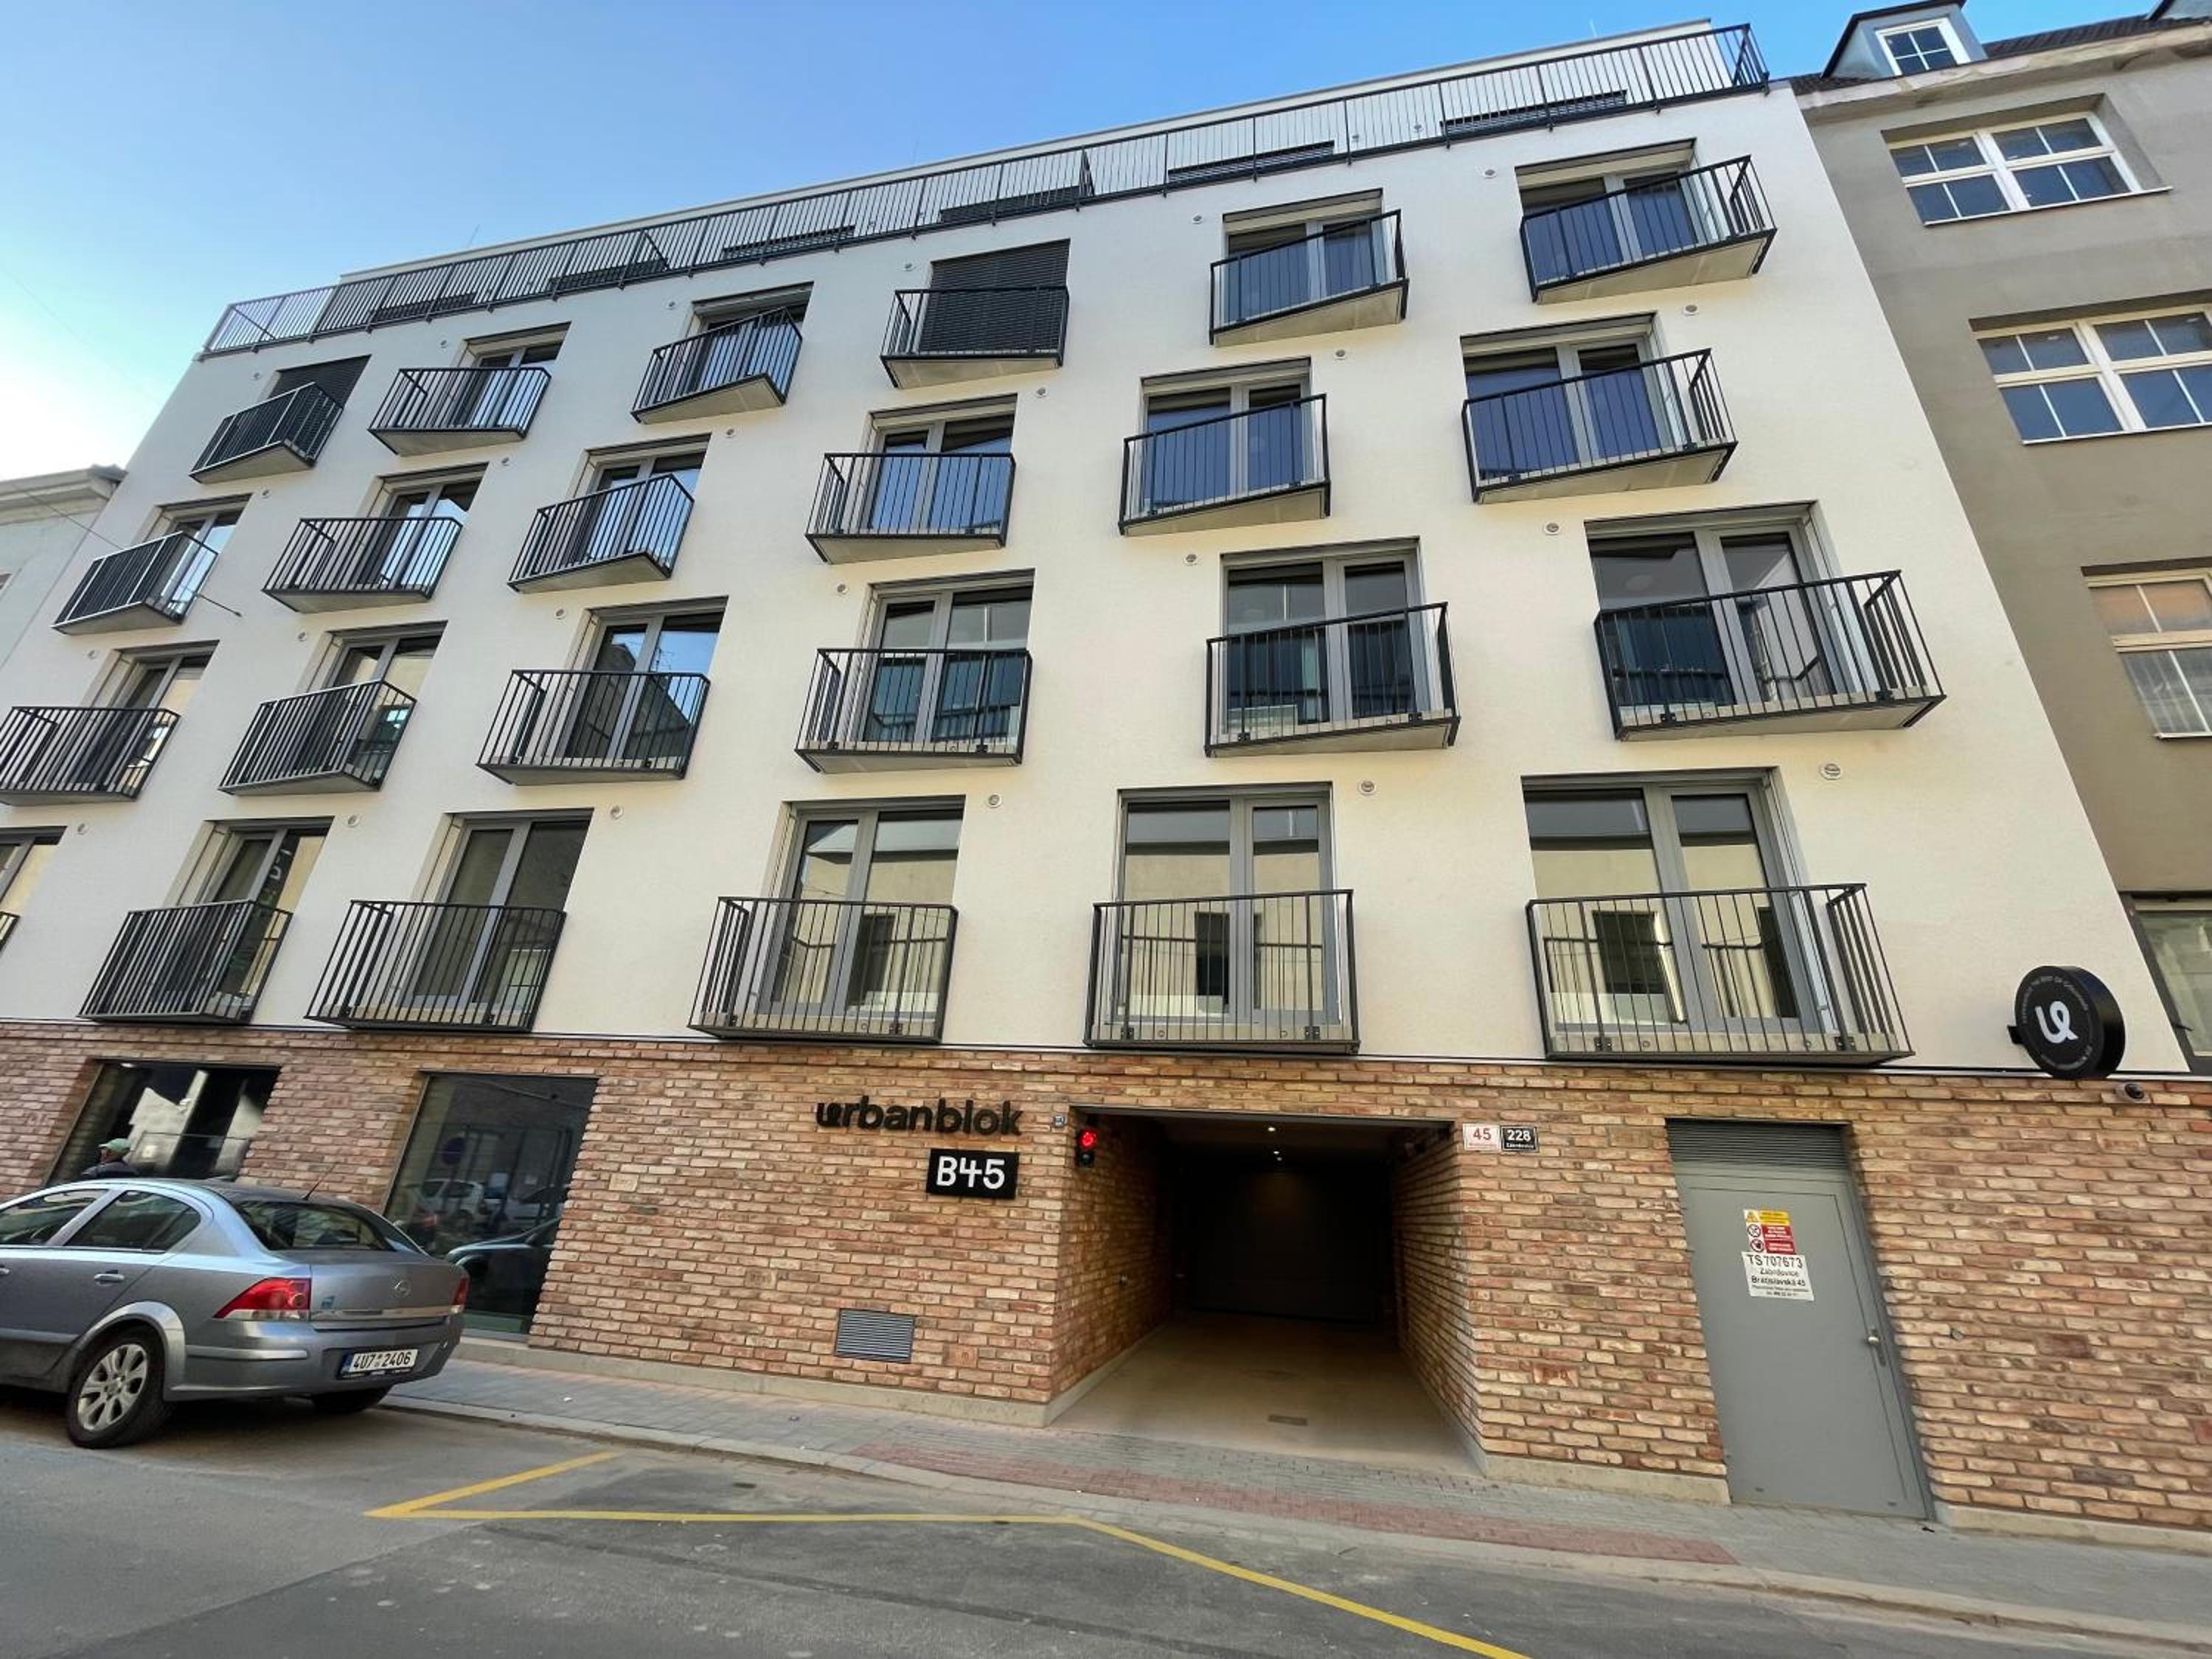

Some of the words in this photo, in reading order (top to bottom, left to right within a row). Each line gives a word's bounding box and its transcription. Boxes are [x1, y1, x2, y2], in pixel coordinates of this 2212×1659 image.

[815, 1096, 1023, 1136] urbanblok
[1472, 1127, 1492, 1141] 45
[1506, 1129, 1531, 1141] 228
[936, 1155, 1006, 1189] B45
[1747, 1254, 1763, 1266] TS
[353, 1354, 375, 1369] 4U7
[380, 1351, 412, 1368] 2406
